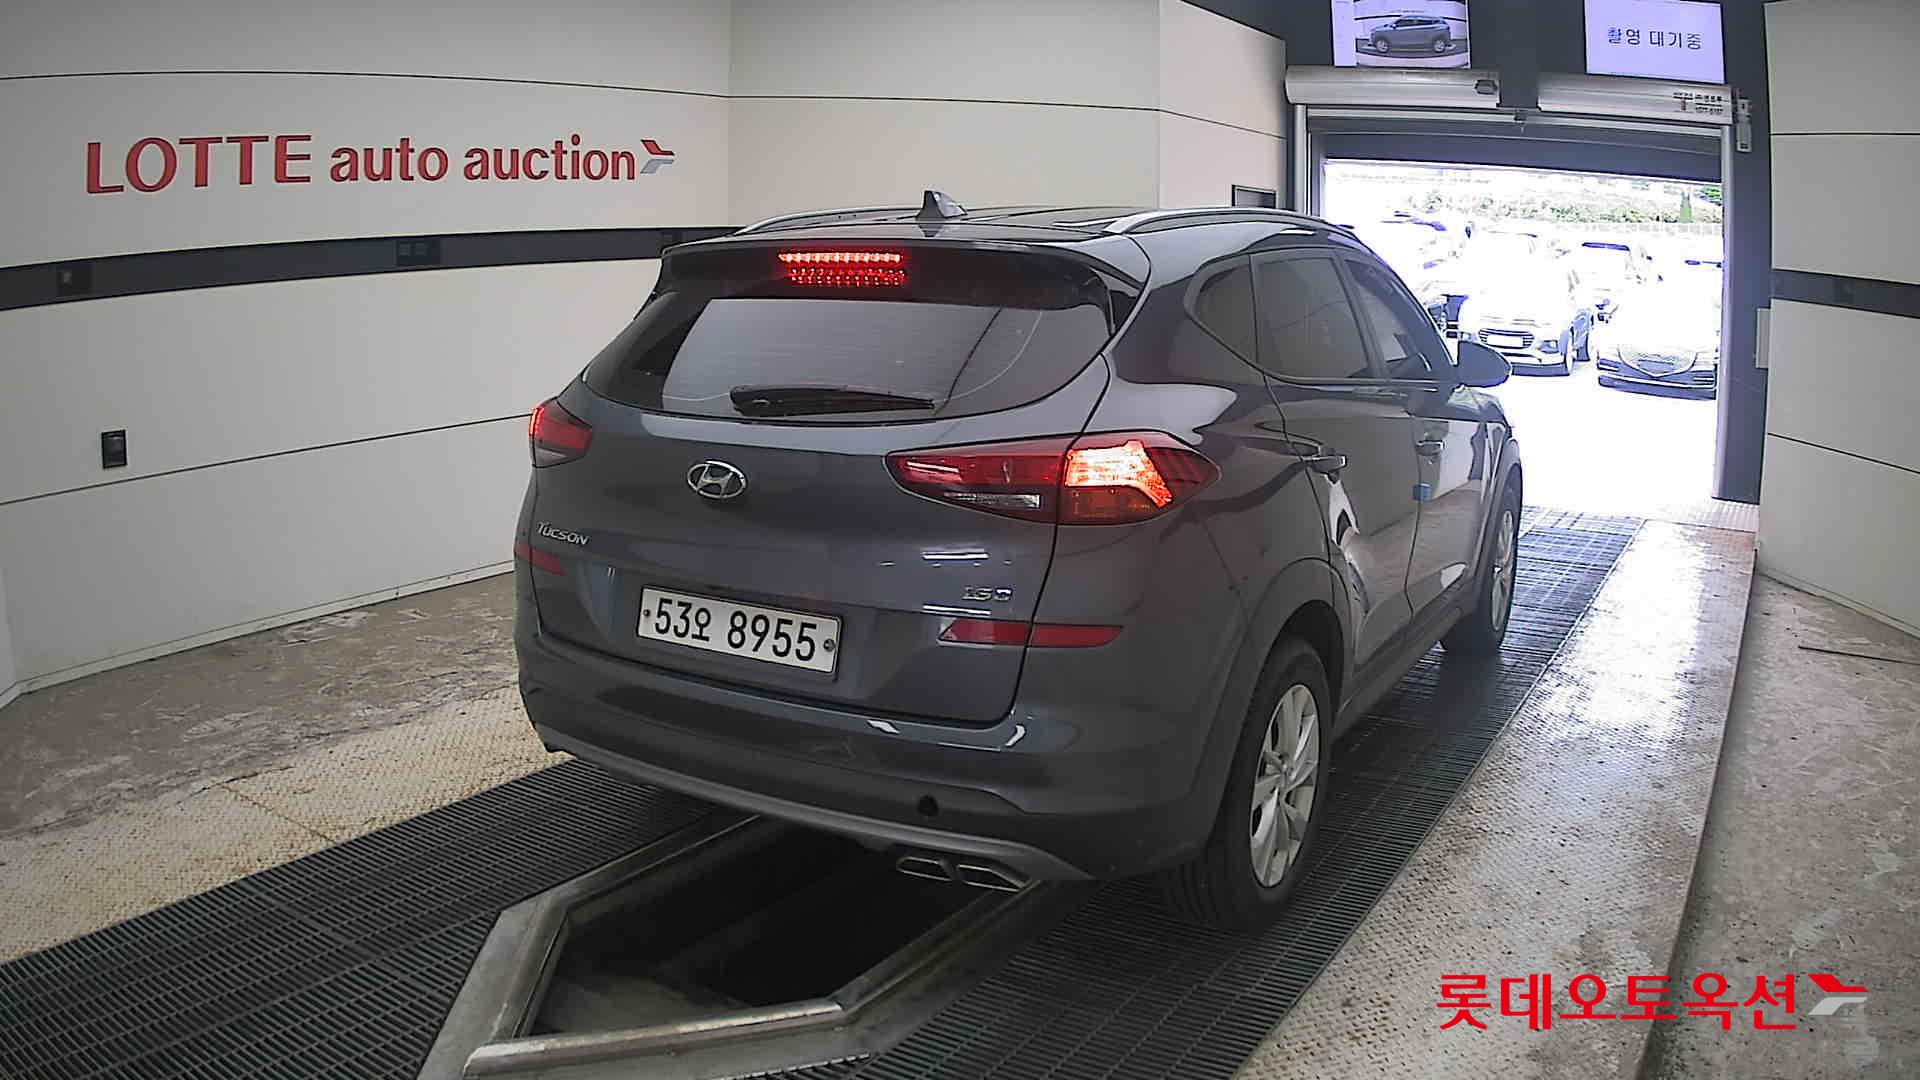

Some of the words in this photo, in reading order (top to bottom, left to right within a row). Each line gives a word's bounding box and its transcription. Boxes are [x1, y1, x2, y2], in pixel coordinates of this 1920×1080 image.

[1607, 27, 1641, 46] 촬영
[1649, 30, 1701, 50] 대기중
[87, 135, 312, 193] LOTTE
[330, 137, 448, 182] auto
[463, 134, 635, 181] auction
[537, 521, 591, 545] TUCSON
[654, 597, 711, 642] 53오
[727, 610, 817, 662] 8955
